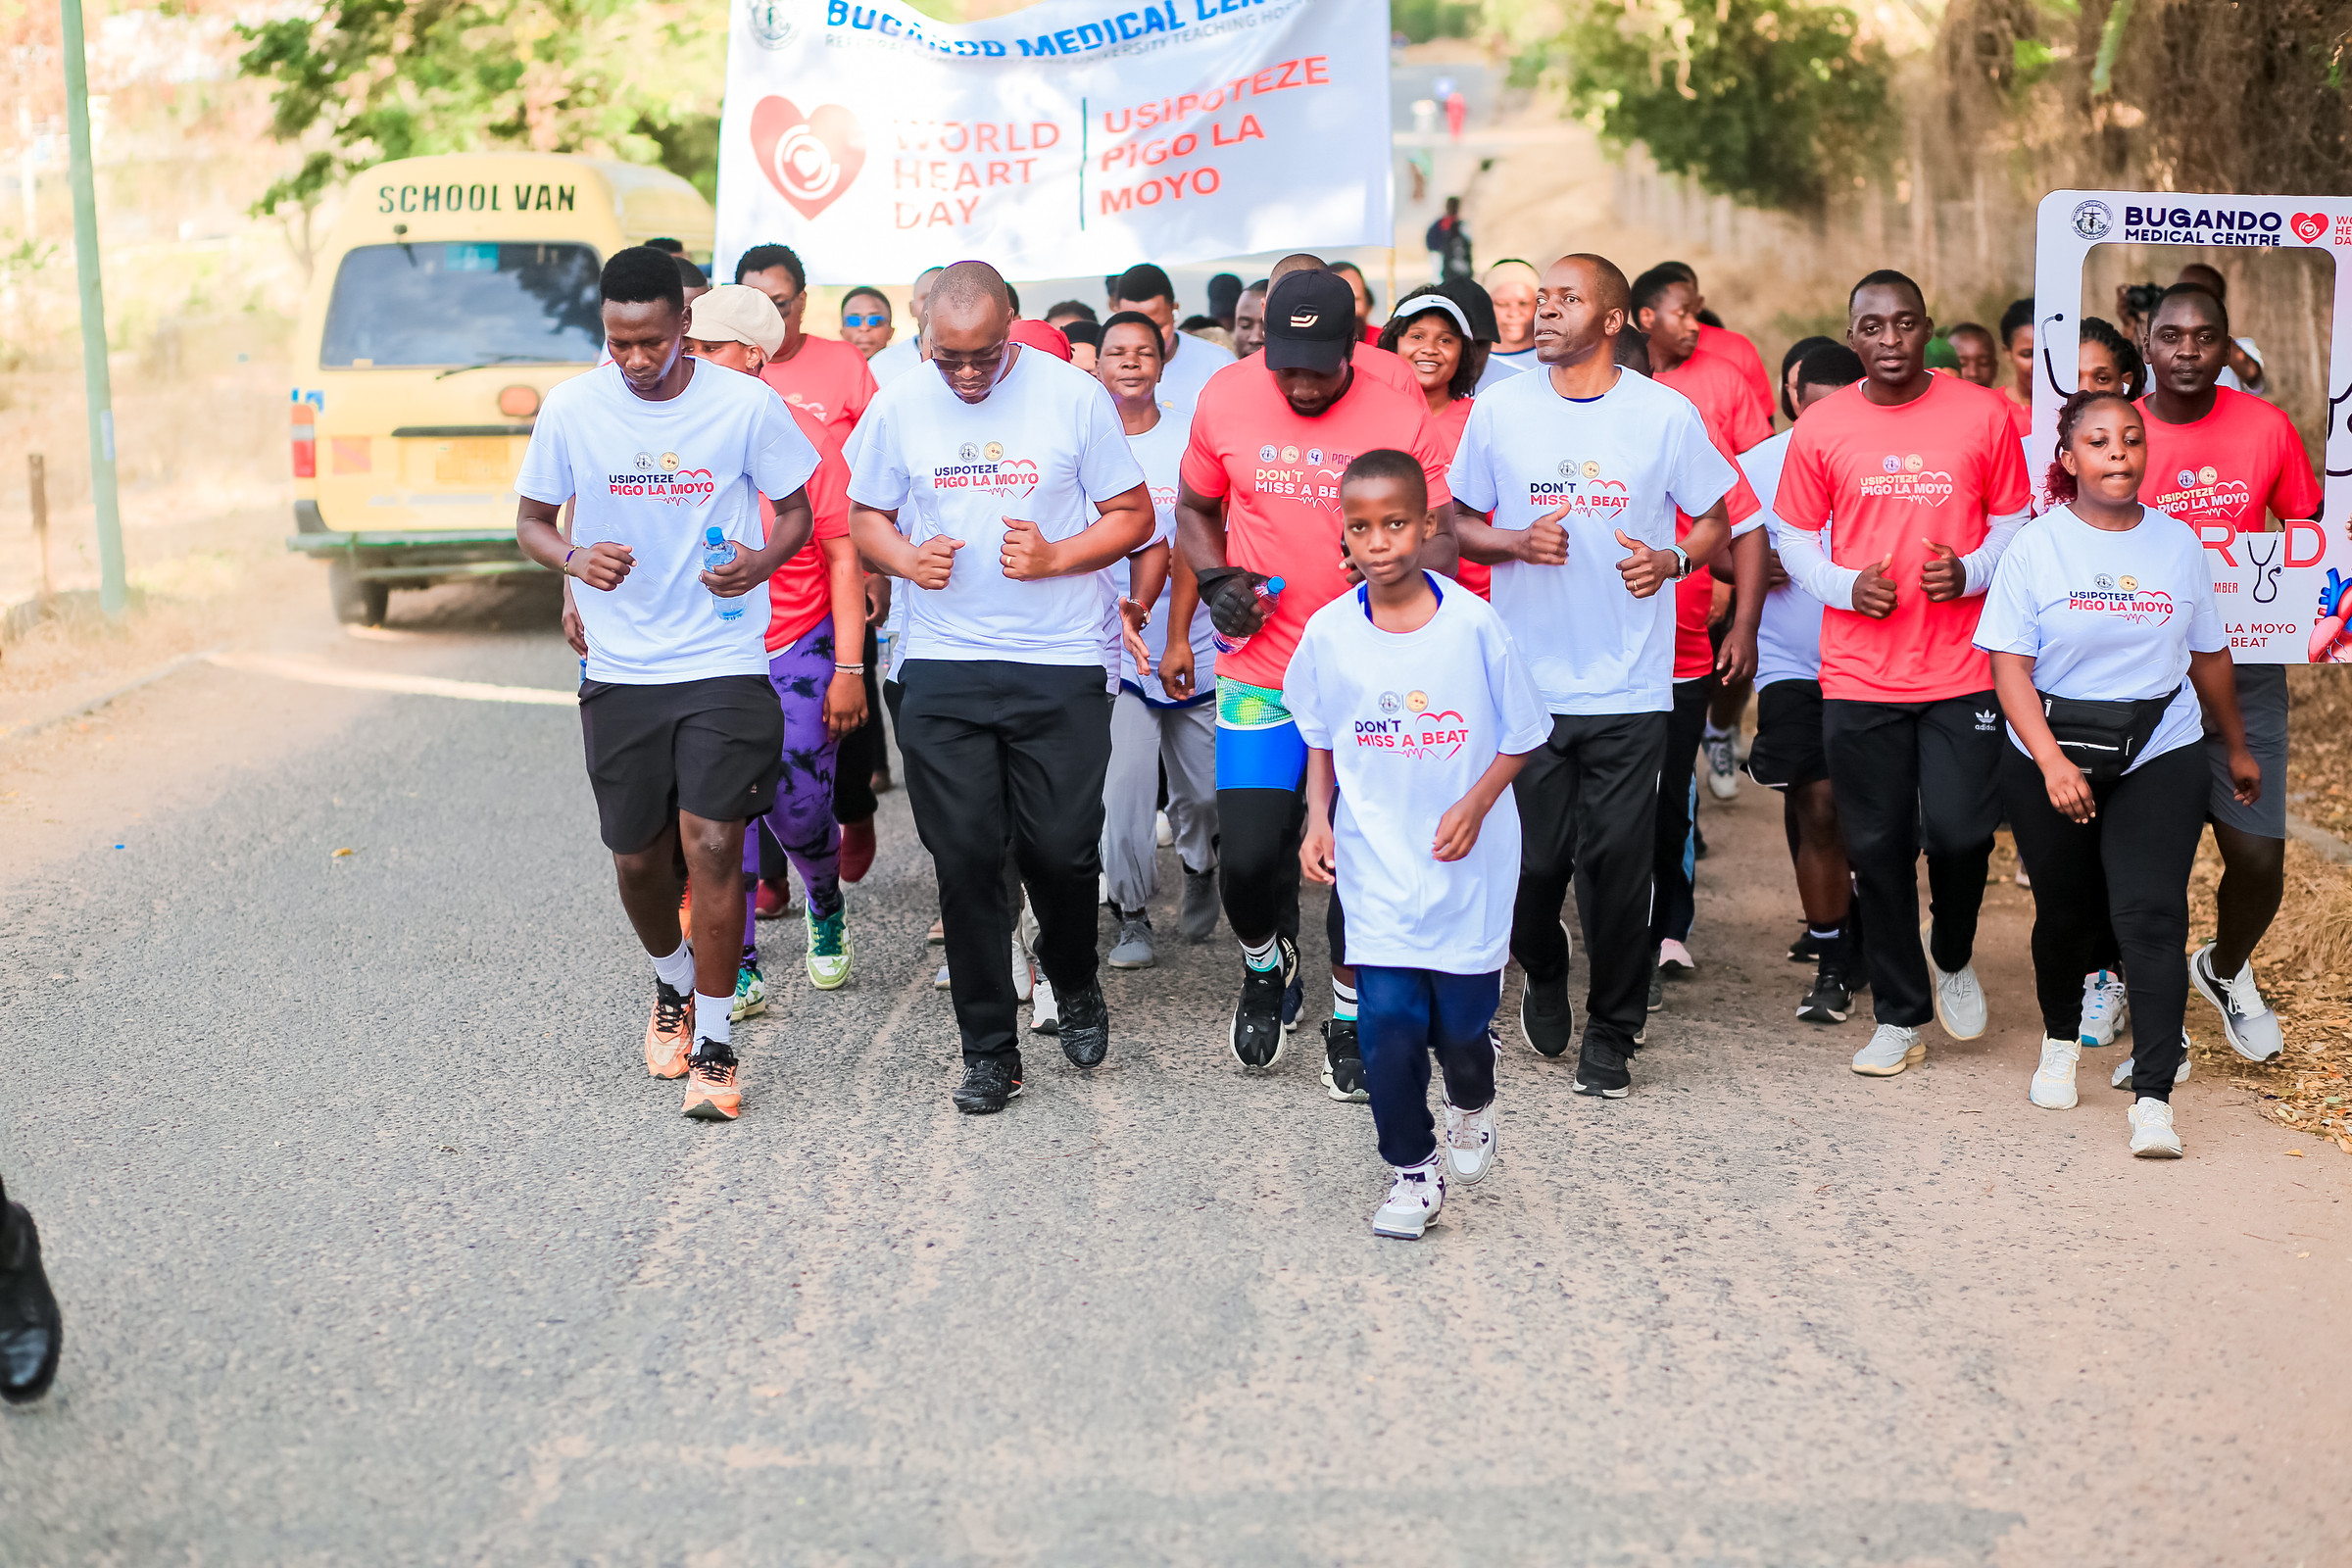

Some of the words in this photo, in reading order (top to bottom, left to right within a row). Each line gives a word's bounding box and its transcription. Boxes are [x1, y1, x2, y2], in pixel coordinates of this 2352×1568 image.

[1016, 0, 1186, 57] MEDICAL
[1173, 14, 1256, 43] TEACHING
[1103, 55, 1331, 133] USIPOTEZE
[1101, 132, 1198, 172] PIGO
[1212, 113, 1266, 147] LA
[894, 157, 1039, 191] HEART
[379, 184, 502, 213] SCHOOL
[515, 184, 574, 211] VAN
[1100, 166, 1221, 216] MOYO
[895, 195, 980, 229] DAY
[2125, 206, 2282, 232] BUGANDO
[2125, 228, 2205, 243] MEDICAL
[2211, 232, 2280, 246] CENTRE
[934, 464, 999, 476] USIPOTEZE
[1255, 468, 1304, 482] DON'T
[609, 474, 674, 484] USIPOTEZE
[934, 475, 969, 489] PIGO
[972, 474, 991, 486] LA
[995, 472, 1039, 485] MOYO
[1530, 481, 1577, 493] DON'T
[1860, 474, 1919, 486] USIPOTEZE
[610, 484, 644, 496] PIGO
[648, 484, 666, 495] LA
[670, 481, 714, 495] MOYO
[1254, 481, 1296, 495] MISS
[1299, 484, 1312, 496] A
[1318, 485, 1340, 499] BE
[1860, 484, 1892, 497] PIGO
[1894, 483, 1911, 494] LA
[1914, 483, 1953, 495] MOYO
[2156, 486, 2215, 504] USIPOTEZE
[1530, 495, 1569, 506] MISS
[1575, 495, 1586, 506] A
[1592, 496, 1630, 508] BEAT
[2157, 500, 2188, 514] PIGO
[2191, 498, 2208, 510] LA
[2211, 492, 2250, 507] MOYO
[2069, 591, 2134, 601] USIPOTEZE
[2069, 599, 2105, 612] PIGO
[2109, 601, 2128, 612] LA
[2132, 602, 2174, 614] MOYO
[2225, 623, 2244, 633] LA
[2251, 623, 2296, 634] MOYO
[2230, 637, 2268, 647] BEAT
[1354, 718, 1401, 733] DON'T
[1356, 734, 1395, 748] MISS
[1401, 734, 1415, 747] A
[1422, 729, 1469, 745] BEAT
